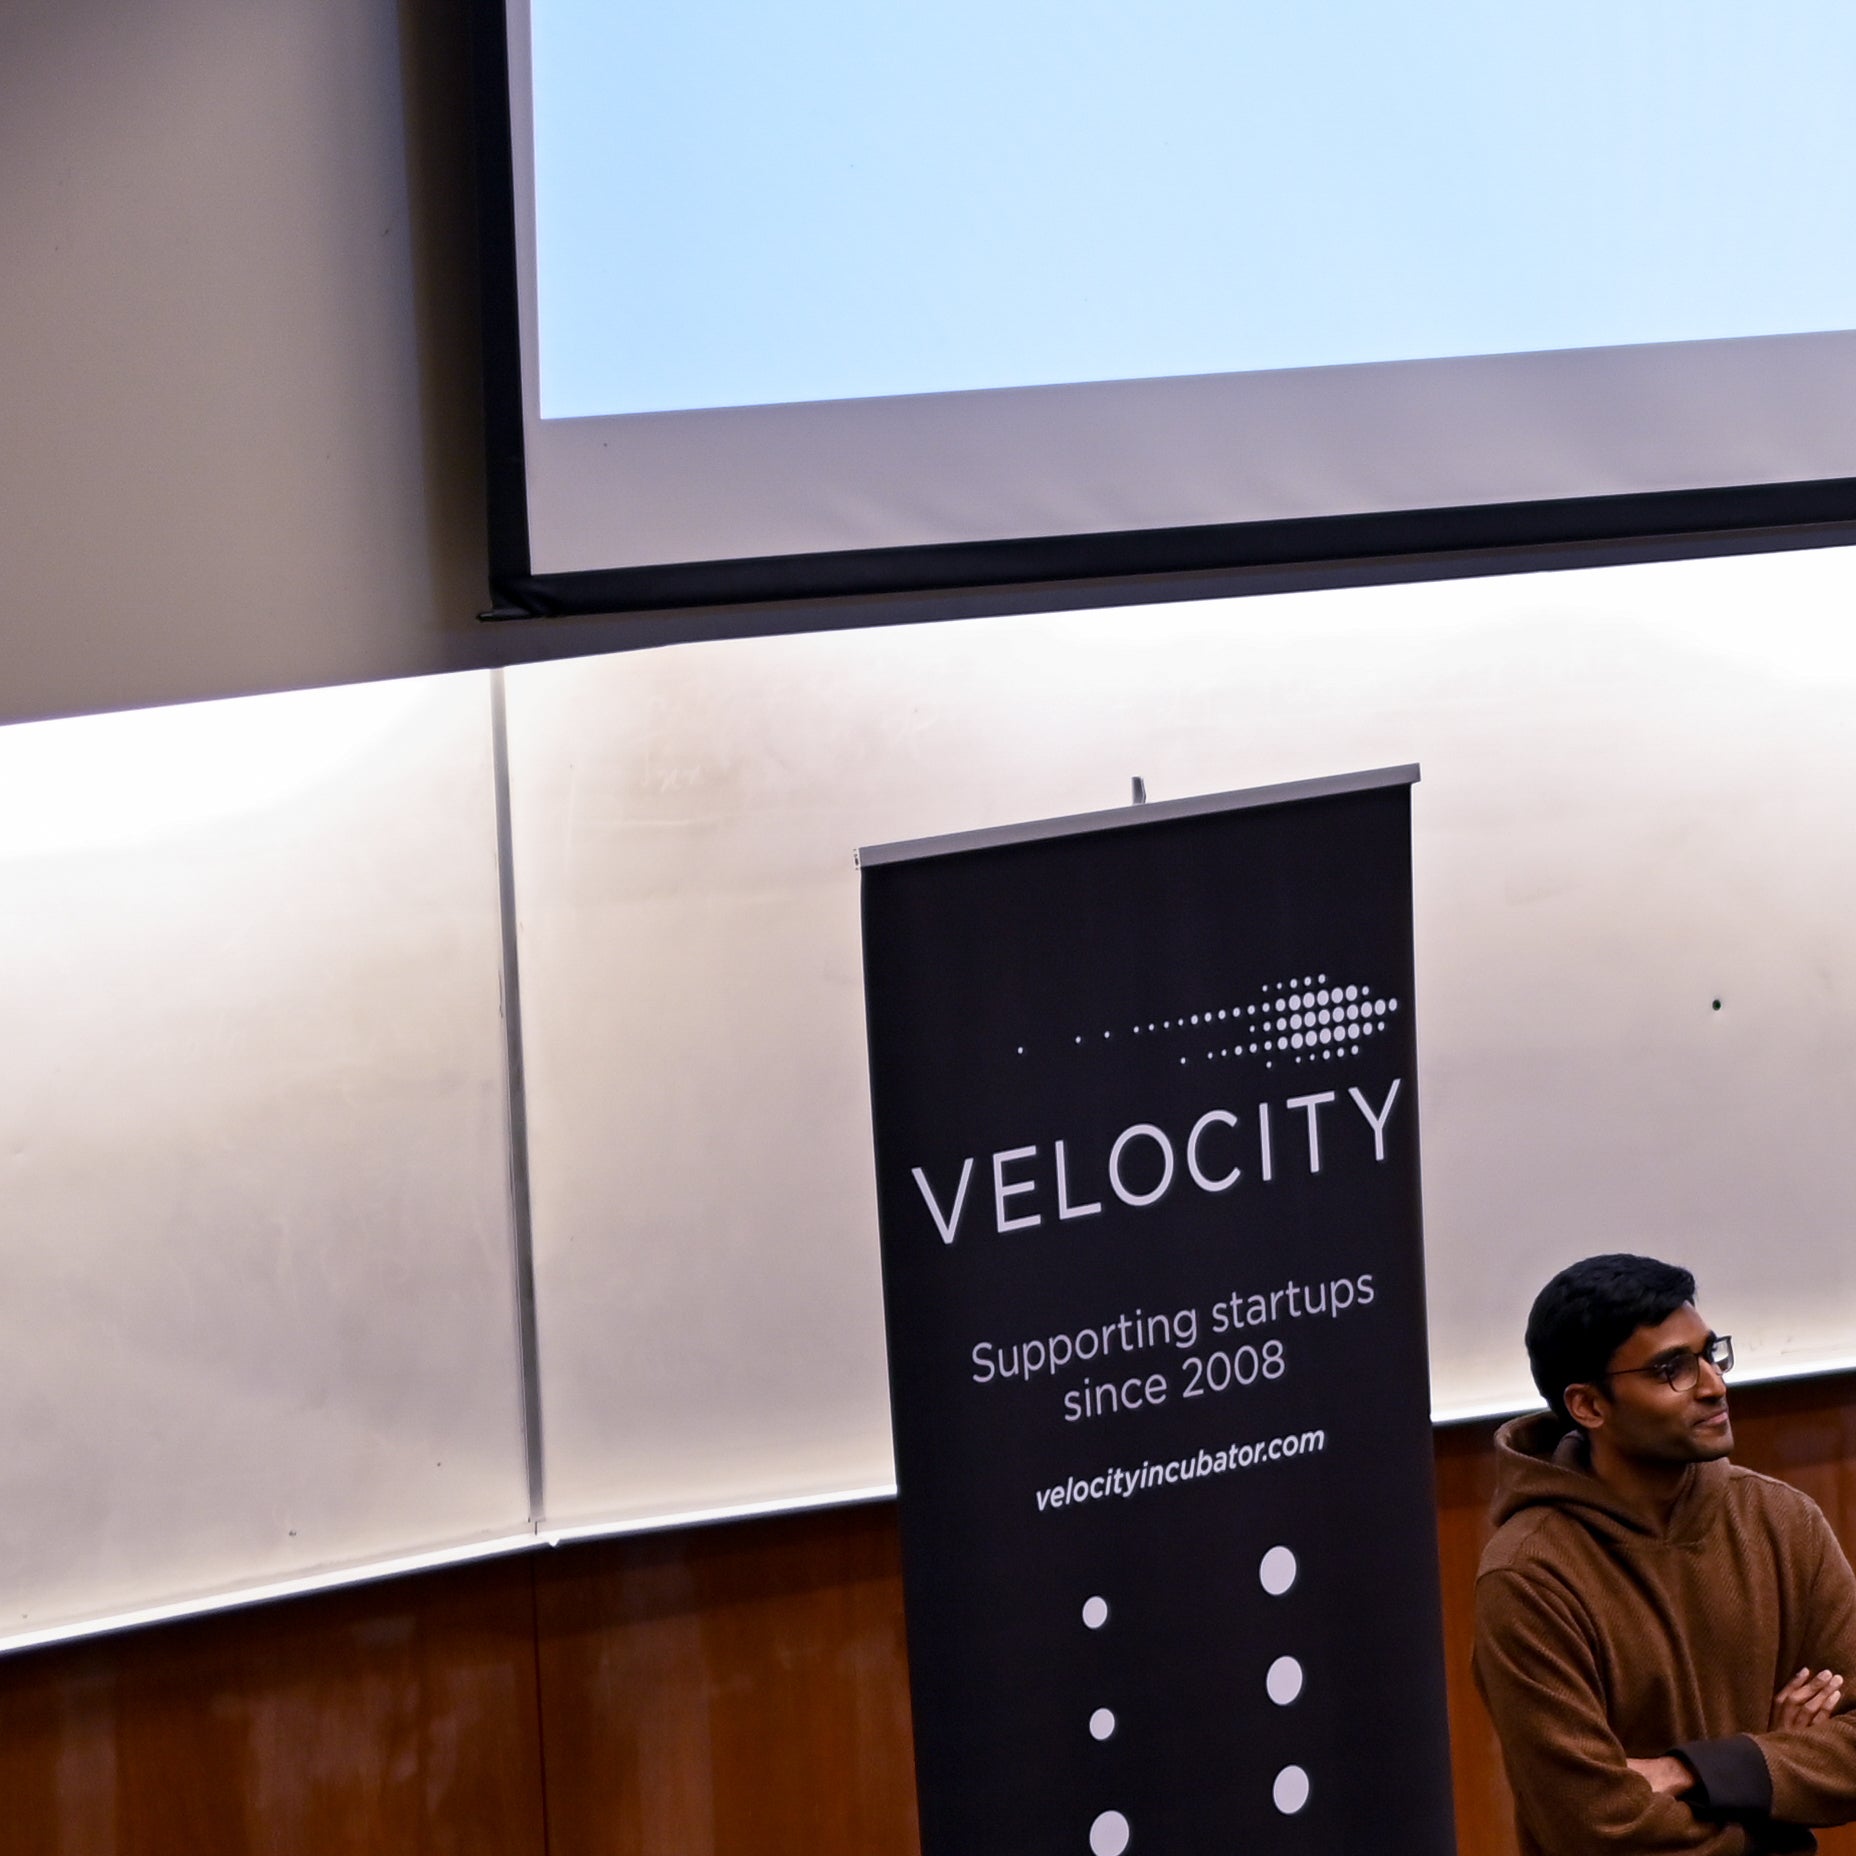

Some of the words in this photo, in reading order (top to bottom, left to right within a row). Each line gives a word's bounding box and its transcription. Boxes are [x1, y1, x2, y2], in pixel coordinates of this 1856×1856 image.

[911, 1078, 1401, 1245] VELOCITY
[971, 1308, 1198, 1384] Supporting
[1211, 1272, 1376, 1335] startups
[1063, 1371, 1168, 1422] since
[1181, 1339, 1287, 1399] 2008
[1034, 1427, 1326, 1512] velocityincubator.com
